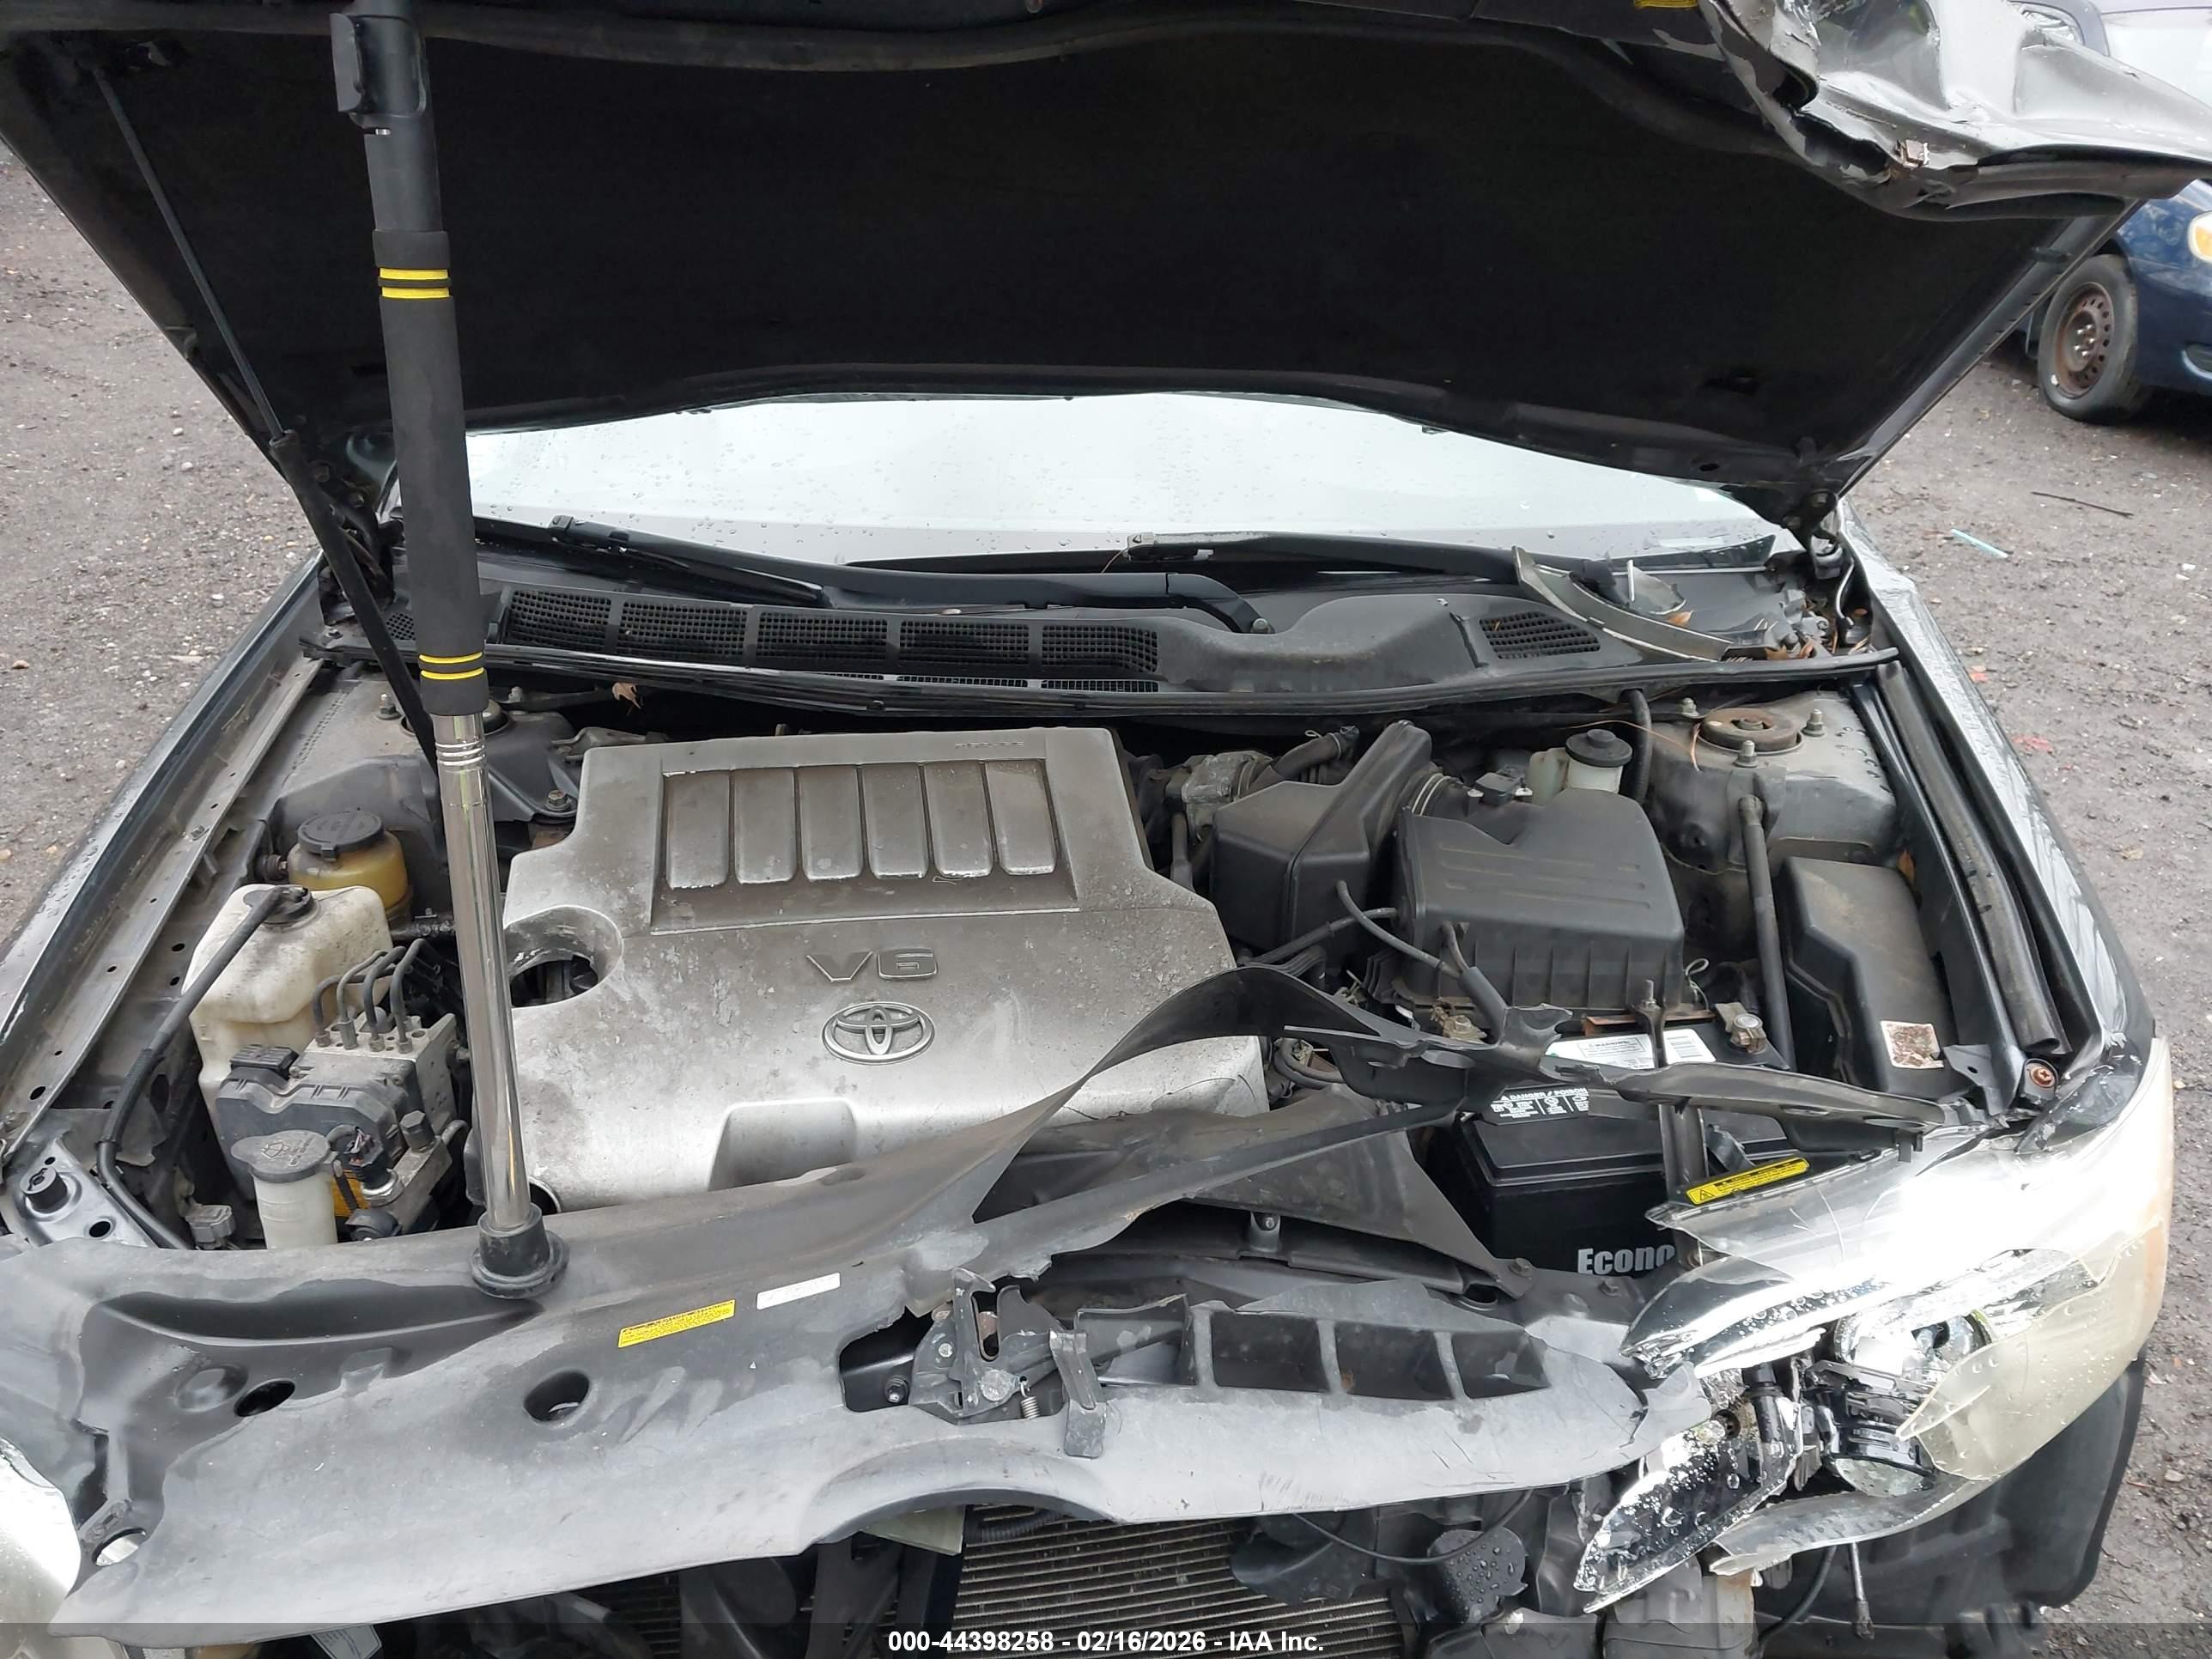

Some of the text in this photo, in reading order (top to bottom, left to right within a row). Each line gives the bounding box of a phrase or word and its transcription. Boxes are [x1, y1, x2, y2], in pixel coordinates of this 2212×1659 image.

[805, 947, 939, 982] V6
[1510, 1091, 1547, 1101] DANGER
[1577, 1244, 1675, 1275] Econo
